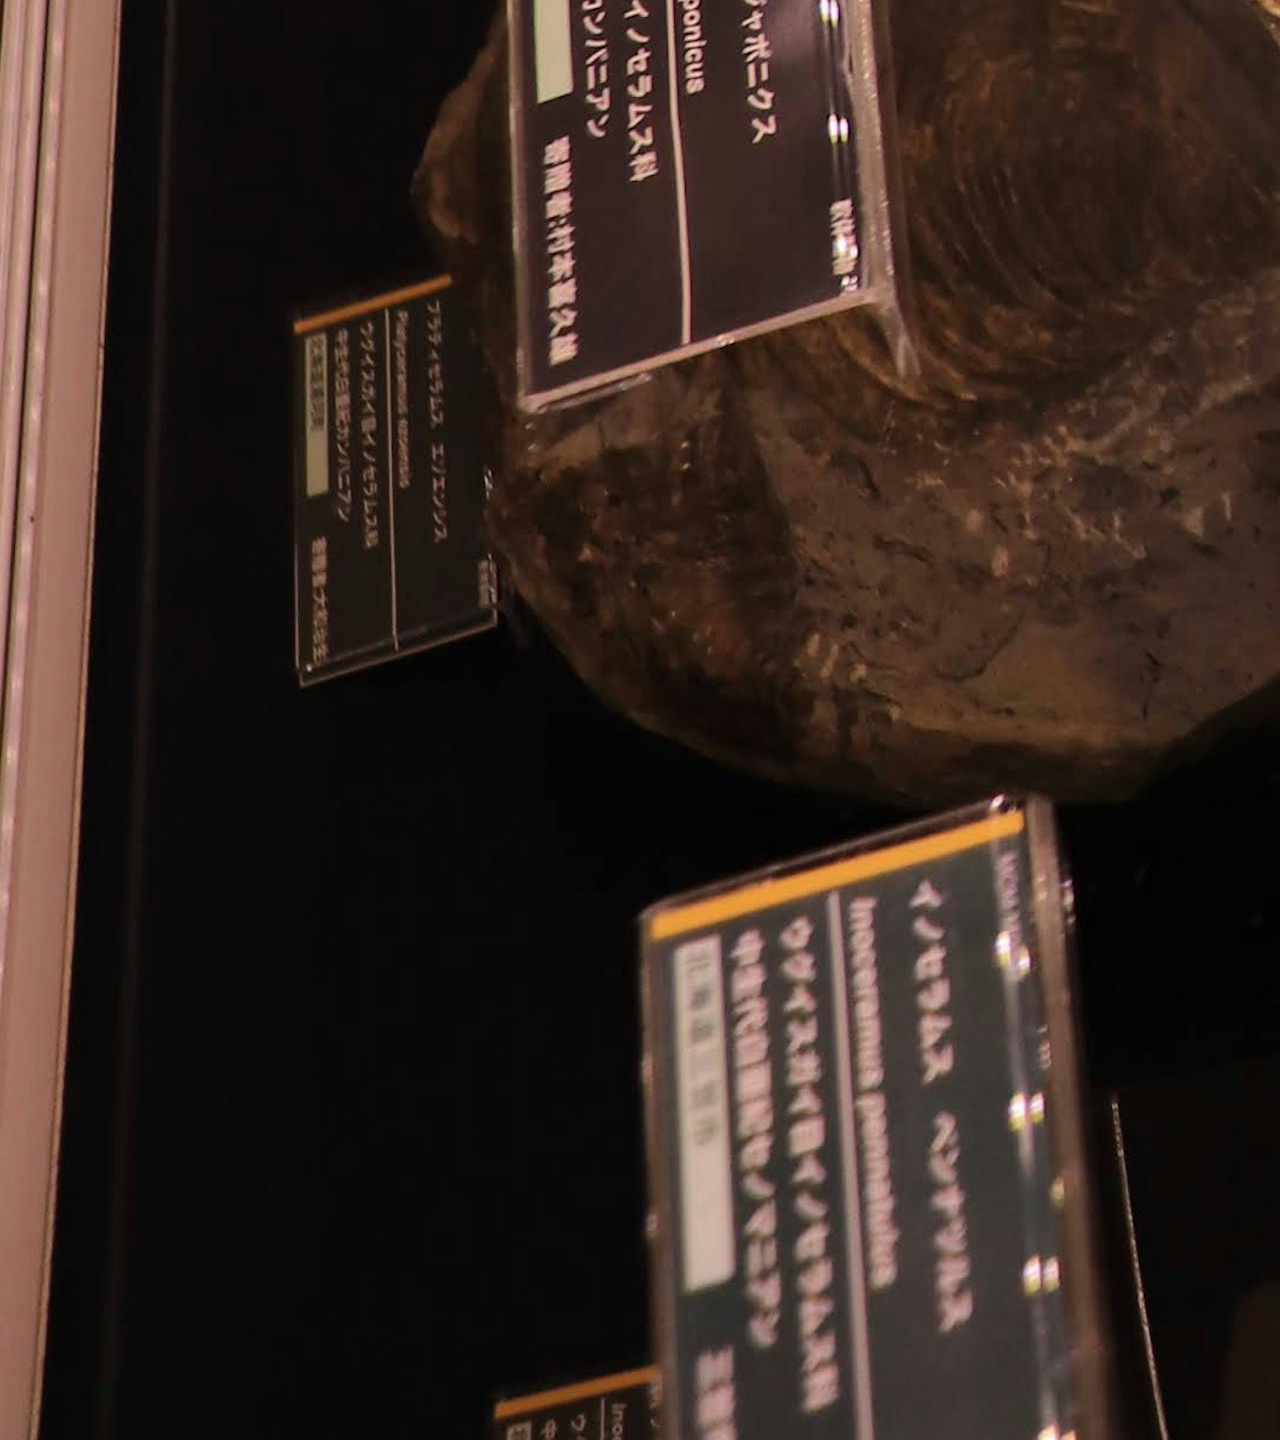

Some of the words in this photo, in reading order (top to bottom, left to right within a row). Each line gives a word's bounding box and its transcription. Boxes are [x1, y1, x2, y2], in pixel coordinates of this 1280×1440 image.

[850, 896, 886, 1089] Inoceramus
[909, 877, 954, 1086] イノセラムス
[779, 915, 836, 1416] ウグイスガイ目イノセラムス科
